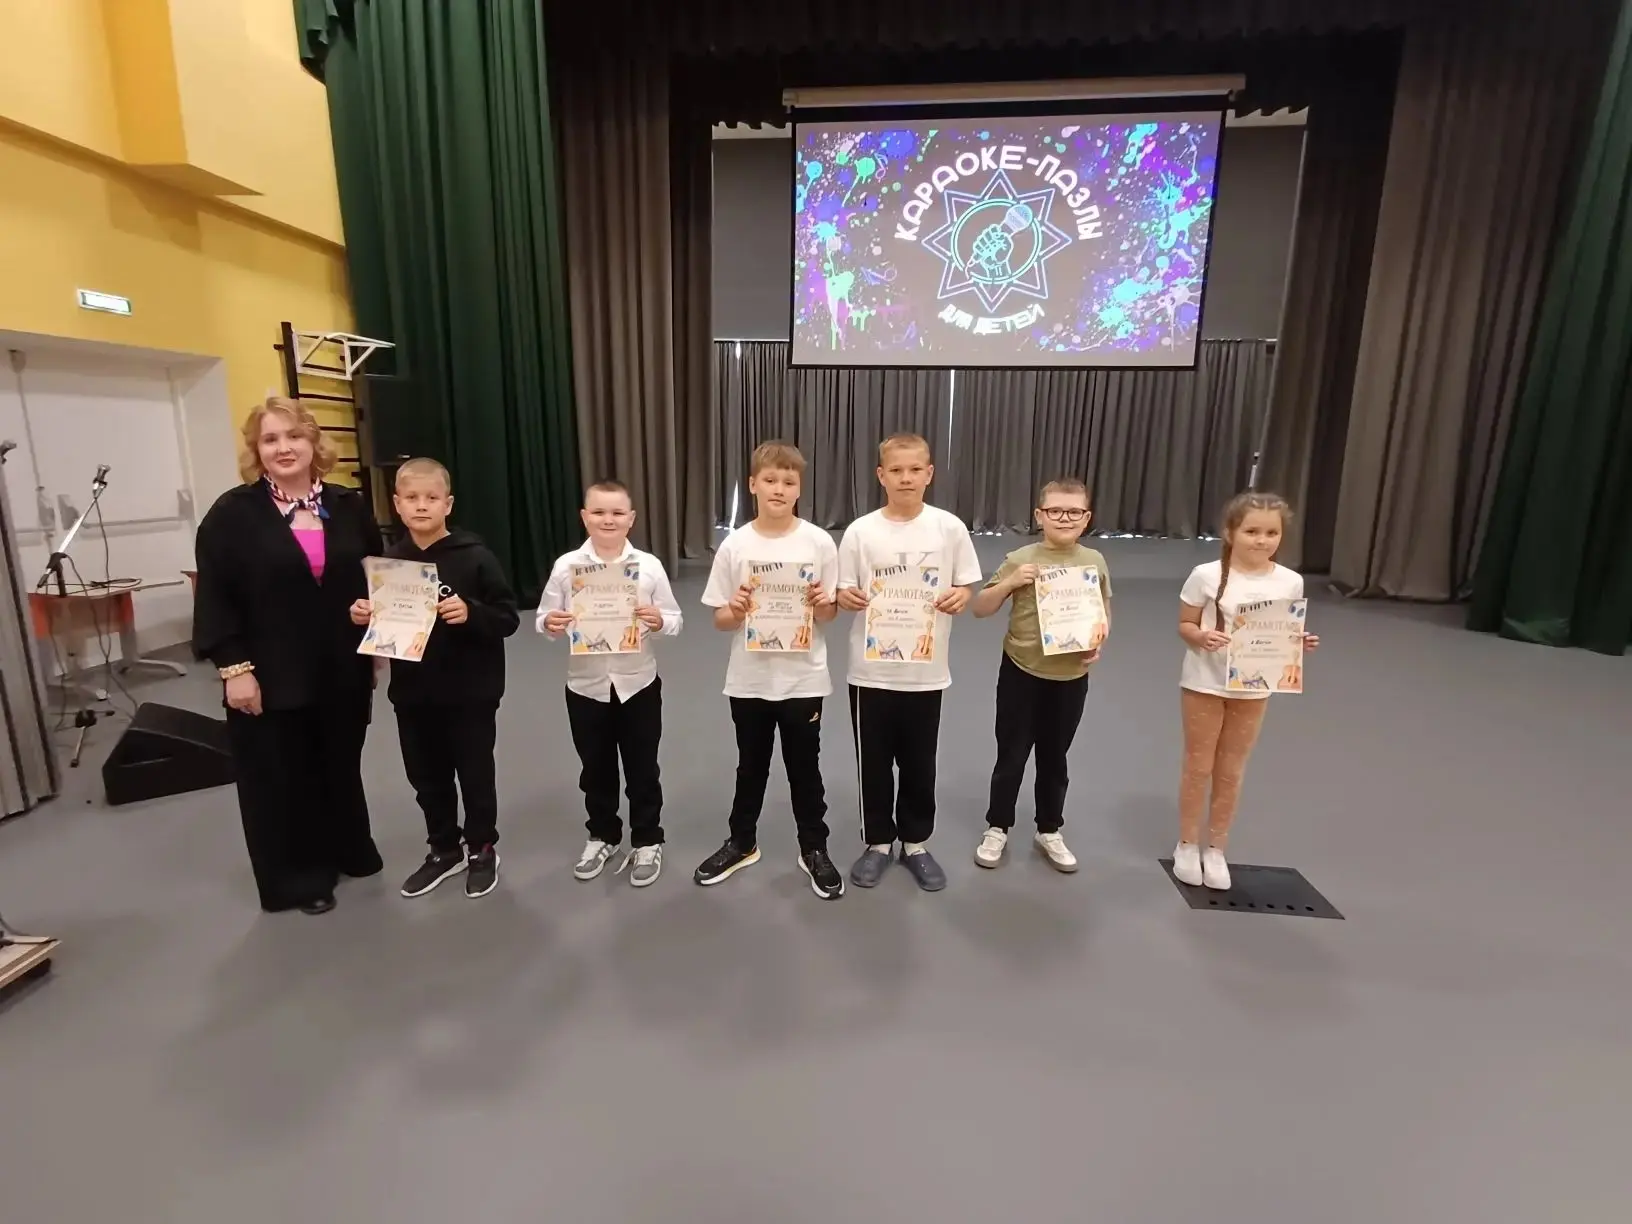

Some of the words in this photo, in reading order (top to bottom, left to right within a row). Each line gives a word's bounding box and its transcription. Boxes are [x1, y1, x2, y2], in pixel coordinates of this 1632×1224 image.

[894, 145, 1103, 240] КАРАОКЕ-ПАЗЛЫ
[938, 303, 974, 330] ДЛЯ
[973, 303, 1045, 335] ДЕТЕЙ
[762, 584, 804, 595] ГРАМОТА
[883, 588, 925, 600] ГРАМОТА
